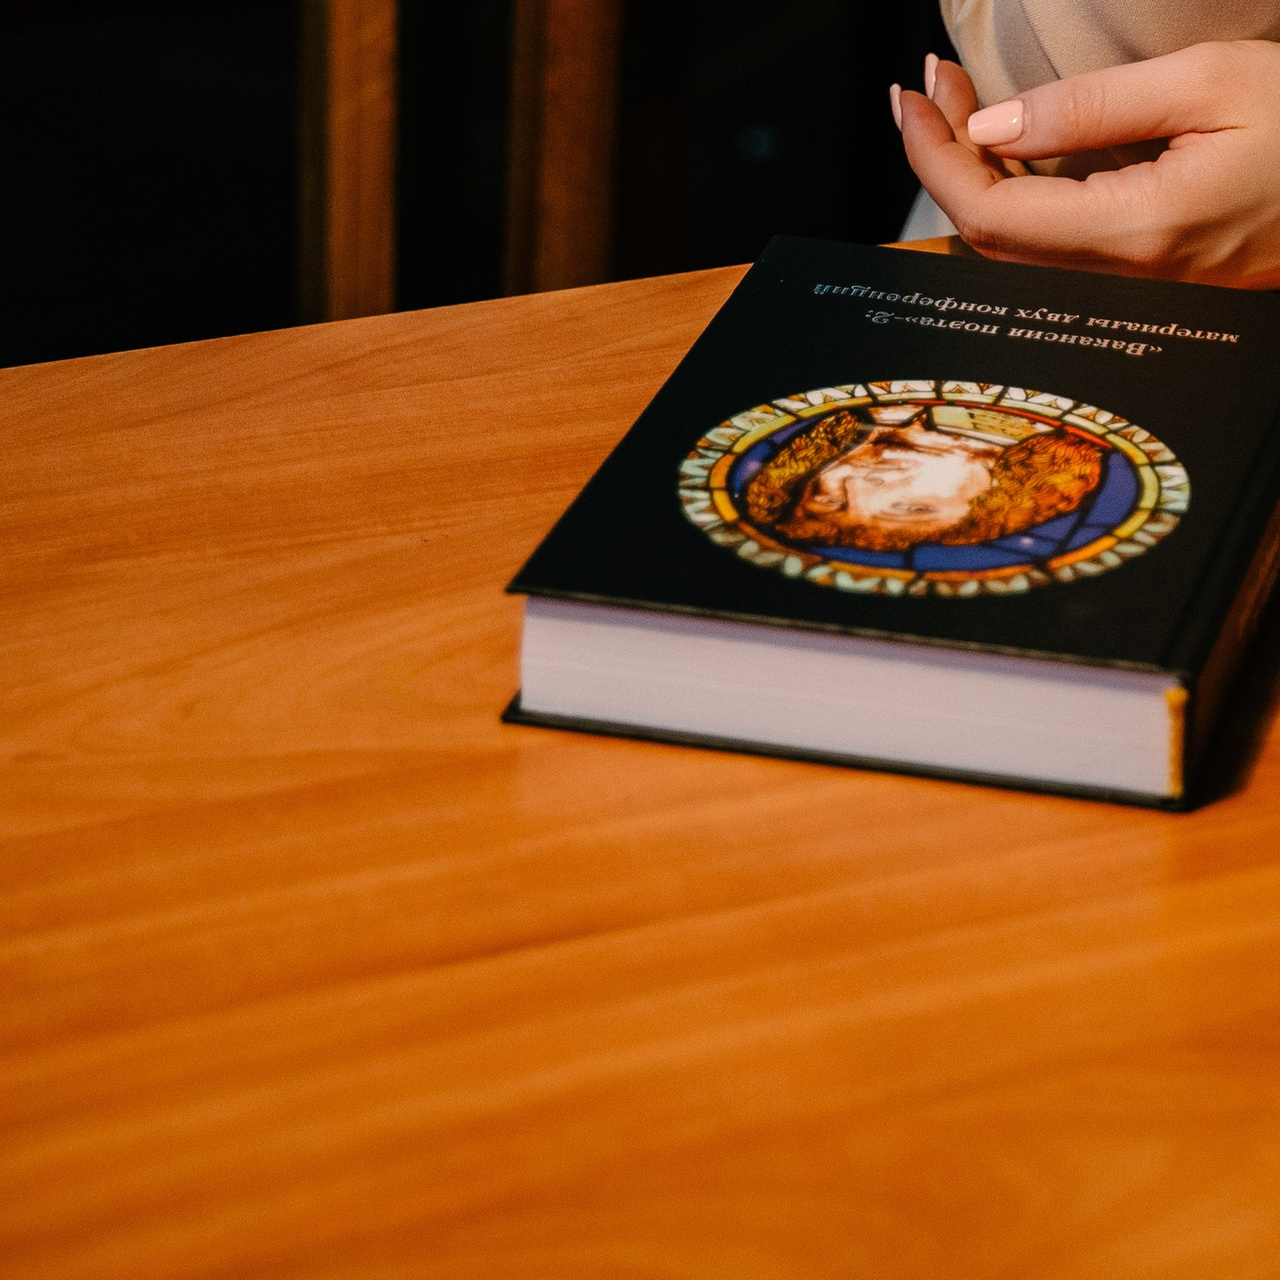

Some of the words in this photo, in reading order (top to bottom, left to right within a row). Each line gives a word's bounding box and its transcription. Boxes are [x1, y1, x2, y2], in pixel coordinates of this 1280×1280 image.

[813, 282, 1010, 317] конференций
[1016, 305, 1080, 328] двух
[1087, 315, 1241, 344] материалы
[1008, 325, 1164, 357] «Вакансия
